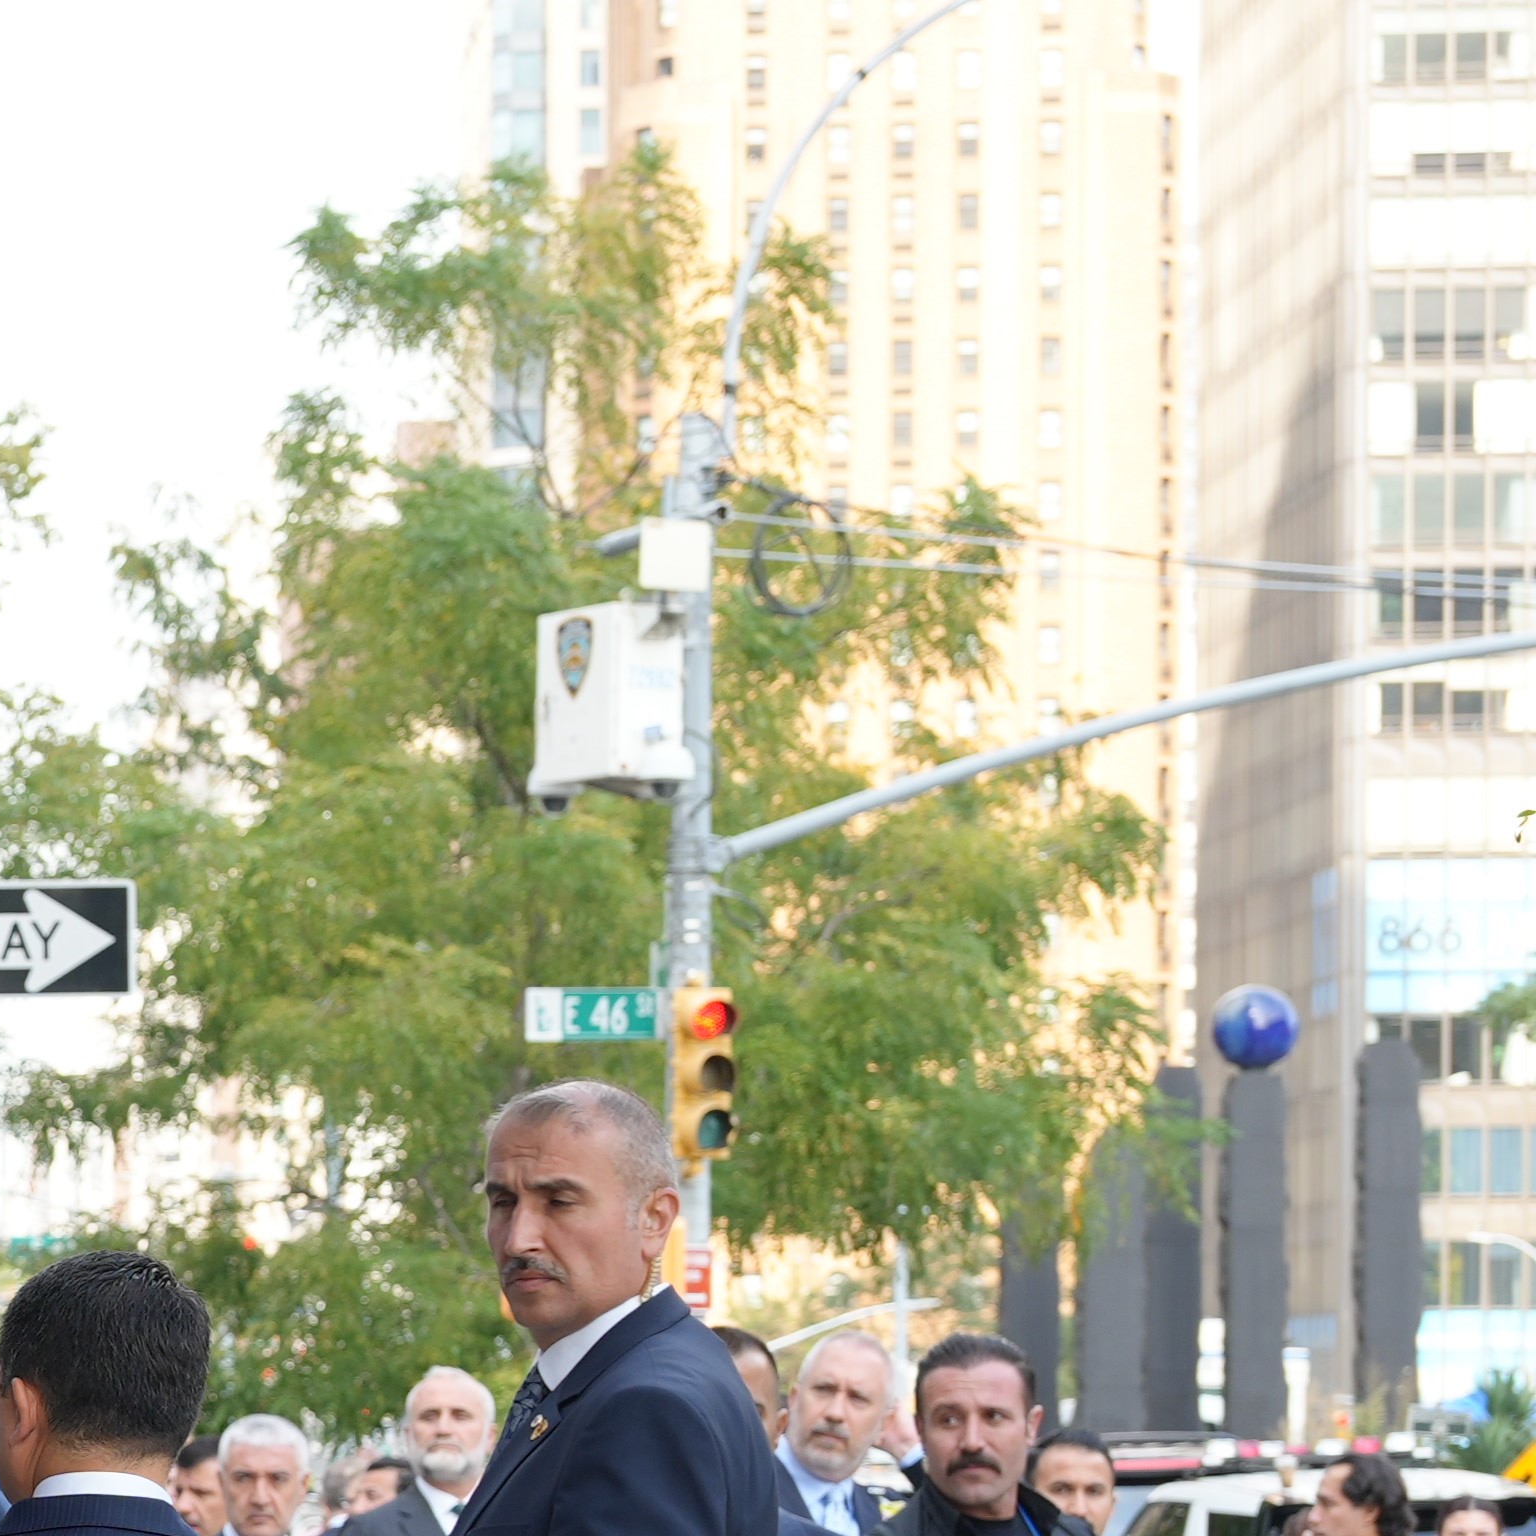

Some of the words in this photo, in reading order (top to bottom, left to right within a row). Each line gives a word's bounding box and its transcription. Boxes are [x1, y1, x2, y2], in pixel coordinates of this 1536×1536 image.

[1379, 916, 1462, 954] 866
[564, 995, 582, 1035] E
[589, 995, 630, 1035] 46
